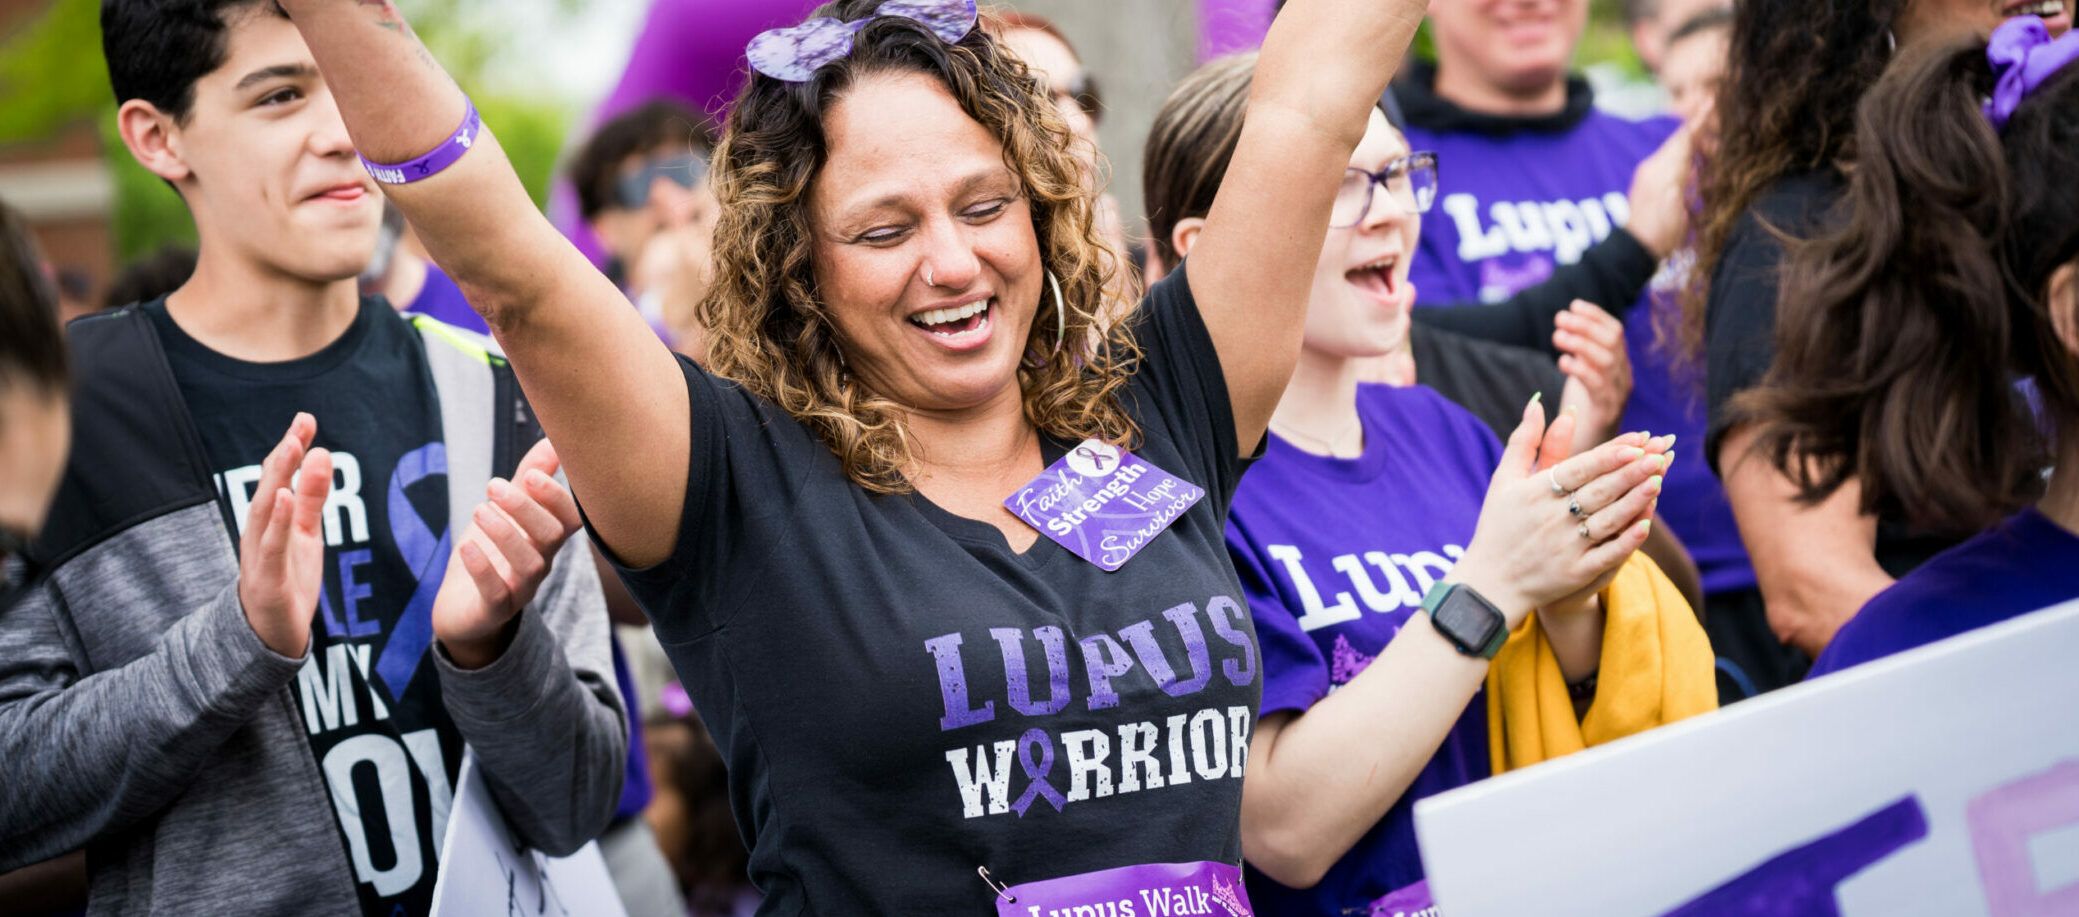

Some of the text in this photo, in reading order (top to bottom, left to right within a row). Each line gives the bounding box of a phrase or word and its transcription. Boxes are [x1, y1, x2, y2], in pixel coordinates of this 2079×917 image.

[1443, 191, 1632, 265] Lupu
[1016, 469, 1083, 527] Faith
[1047, 462, 1148, 537] Strength
[1101, 488, 1197, 566] Survivor
[1123, 477, 1178, 513] Hope
[297, 642, 389, 735] MY
[924, 595, 1256, 732] LUPUS
[1139, 885, 1212, 917] Walk
